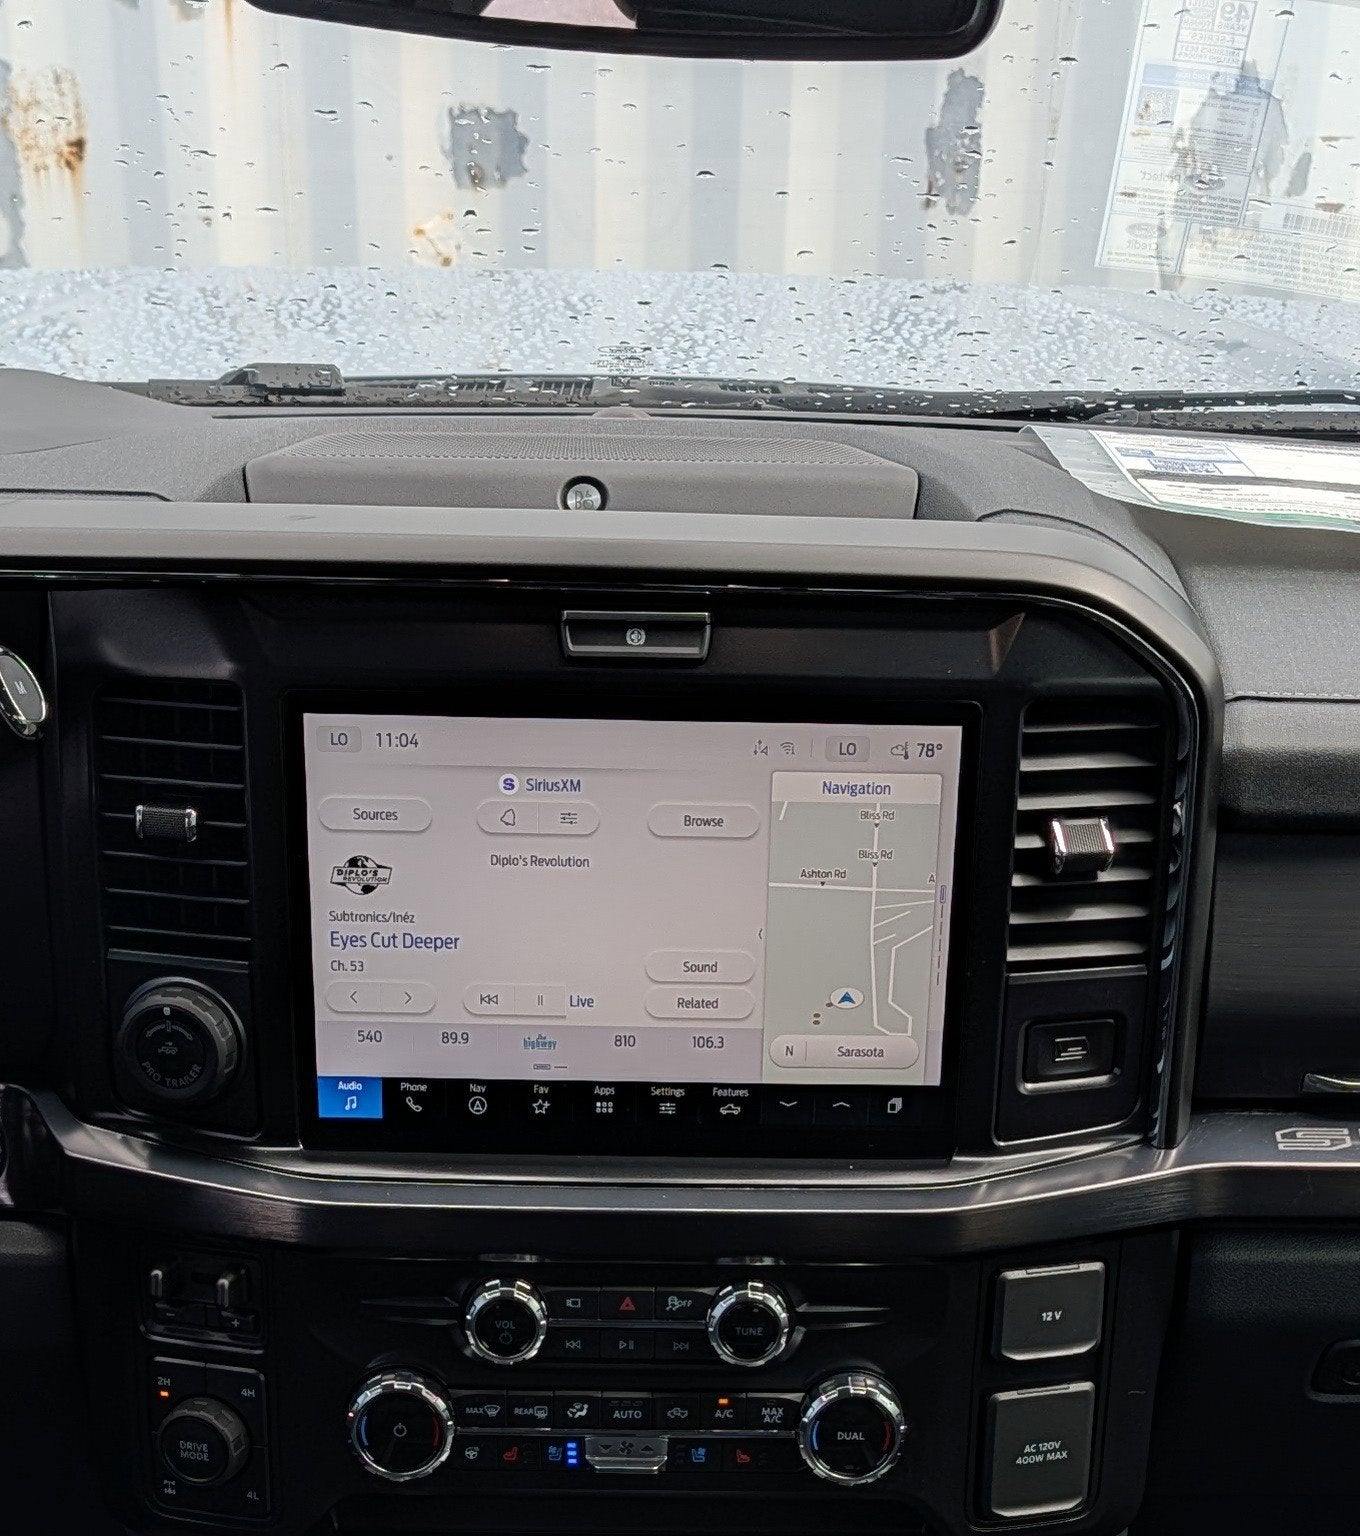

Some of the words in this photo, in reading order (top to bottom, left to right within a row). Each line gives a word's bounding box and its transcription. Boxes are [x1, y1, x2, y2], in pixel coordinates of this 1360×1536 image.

[330, 732, 348, 746] LO
[376, 732, 419, 748] 11:04
[839, 742, 856, 755] LO
[525, 778, 581, 793] SiriusXM
[822, 781, 891, 796] Navigation
[353, 808, 398, 822] Sources
[860, 810, 879, 821] Bliss
[882, 811, 895, 821] Rd
[684, 815, 724, 828] Browse
[858, 849, 878, 860] Bliss
[880, 850, 893, 860] Rd
[490, 854, 528, 868] Diplo's
[530, 854, 590, 868] Revolution
[800, 869, 833, 881] Ashton
[834, 869, 847, 879] Rd
[328, 910, 416, 924] Subtronics/Inéz
[330, 931, 368, 952] Eyes
[370, 932, 399, 949] Cut
[402, 932, 460, 953] Deeper
[330, 960, 347, 972] Ch.
[350, 961, 364, 972] 53
[683, 961, 718, 974] Sound
[569, 994, 595, 1008] Live
[677, 997, 719, 1009] Related
[357, 1030, 382, 1043] 540
[441, 1031, 470, 1045] 89.9
[614, 1034, 636, 1047] 810
[692, 1036, 725, 1050] 106.3
[785, 1045, 794, 1056] N
[837, 1045, 885, 1058] Sarasota
[338, 1081, 363, 1091] Audio
[400, 1082, 428, 1092] Phone
[469, 1083, 486, 1093] Nav
[534, 1085, 549, 1094] Fav
[594, 1085, 615, 1097] Apps
[651, 1086, 685, 1098] Settings
[712, 1087, 749, 1097] Features
[1042, 1312, 1053, 1321] 12
[1054, 1311, 1062, 1320] V
[495, 1320, 516, 1330] VOL
[735, 1327, 764, 1336] TUNE
[157, 1377, 171, 1387] 2H
[240, 1387, 256, 1398] 4H
[613, 1409, 643, 1419] AUTO
[715, 1408, 734, 1418] A/C
[761, 1407, 784, 1416] MAX
[763, 1415, 782, 1424] A/C
[837, 1431, 866, 1441] DUAL
[179, 1441, 209, 1452] DRIVE
[1024, 1443, 1036, 1453] AC
[1038, 1441, 1061, 1451] 120V
[180, 1450, 210, 1462] MODE
[1016, 1453, 1044, 1465] 400W
[1046, 1450, 1068, 1461] MAX
